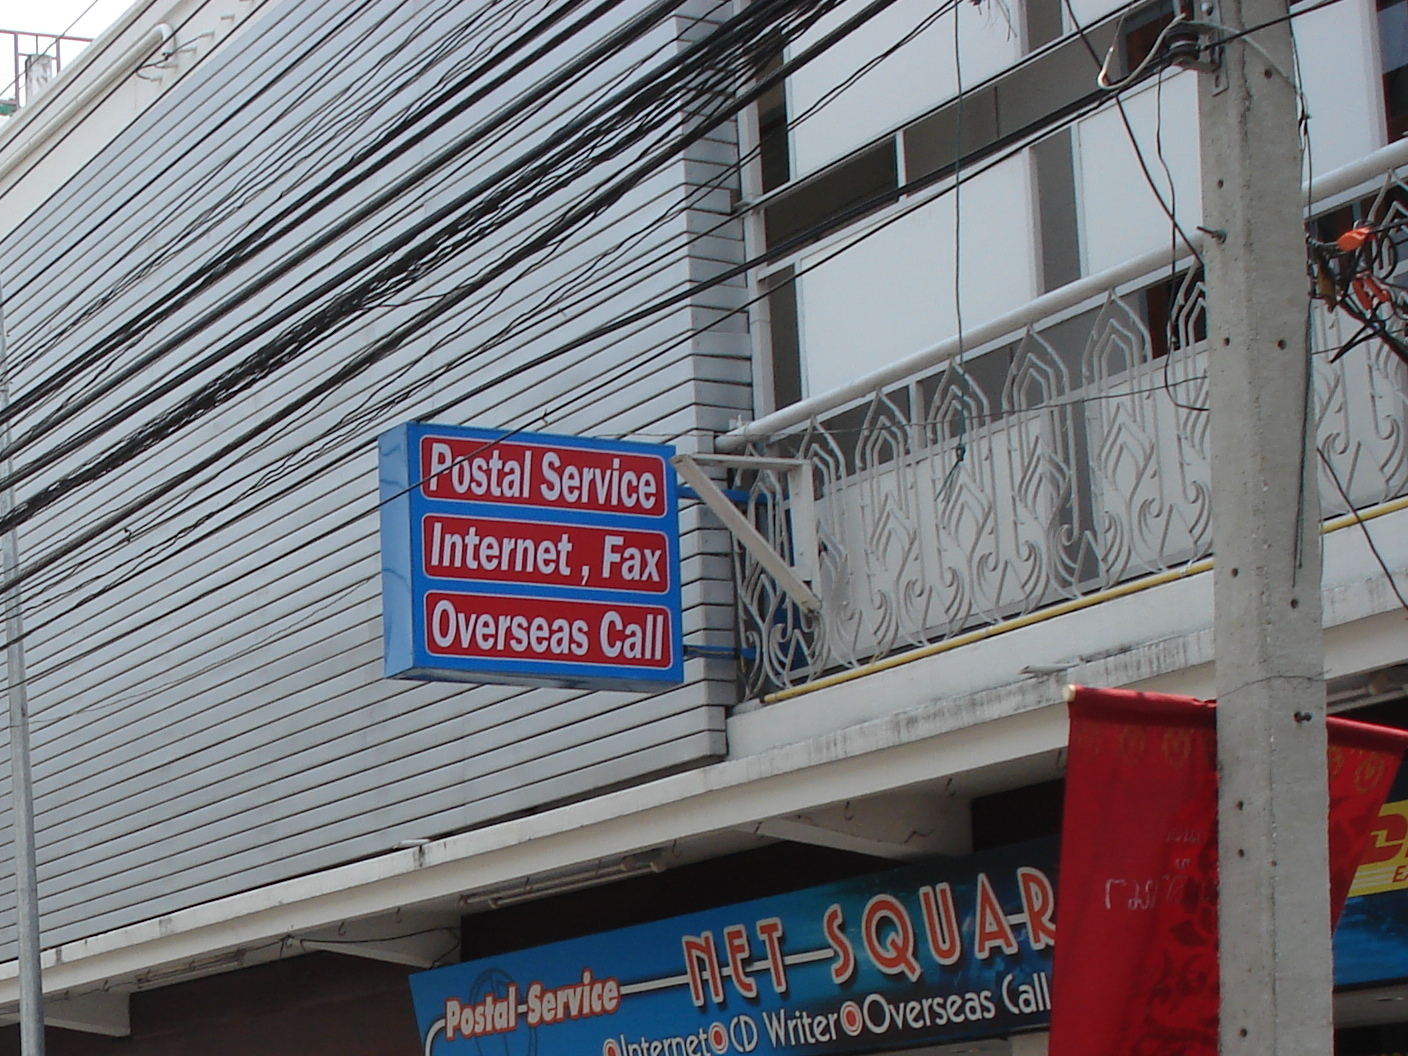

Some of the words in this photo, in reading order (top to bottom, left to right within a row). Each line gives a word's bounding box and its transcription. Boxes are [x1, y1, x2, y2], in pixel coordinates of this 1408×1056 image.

[429, 442, 532, 499] Postal
[541, 452, 657, 509] Service
[430, 522, 573, 576] Internet
[602, 535, 662, 582] Fax
[432, 600, 589, 656] Overseas
[600, 611, 664, 660] Call
[682, 917, 787, 1006] NET
[823, 866, 1056, 983] SQUAR
[730, 1014, 758, 1053] CD
[762, 1008, 838, 1048] Writer
[863, 988, 995, 1034] Overseas
[1002, 971, 1052, 1015] Call
